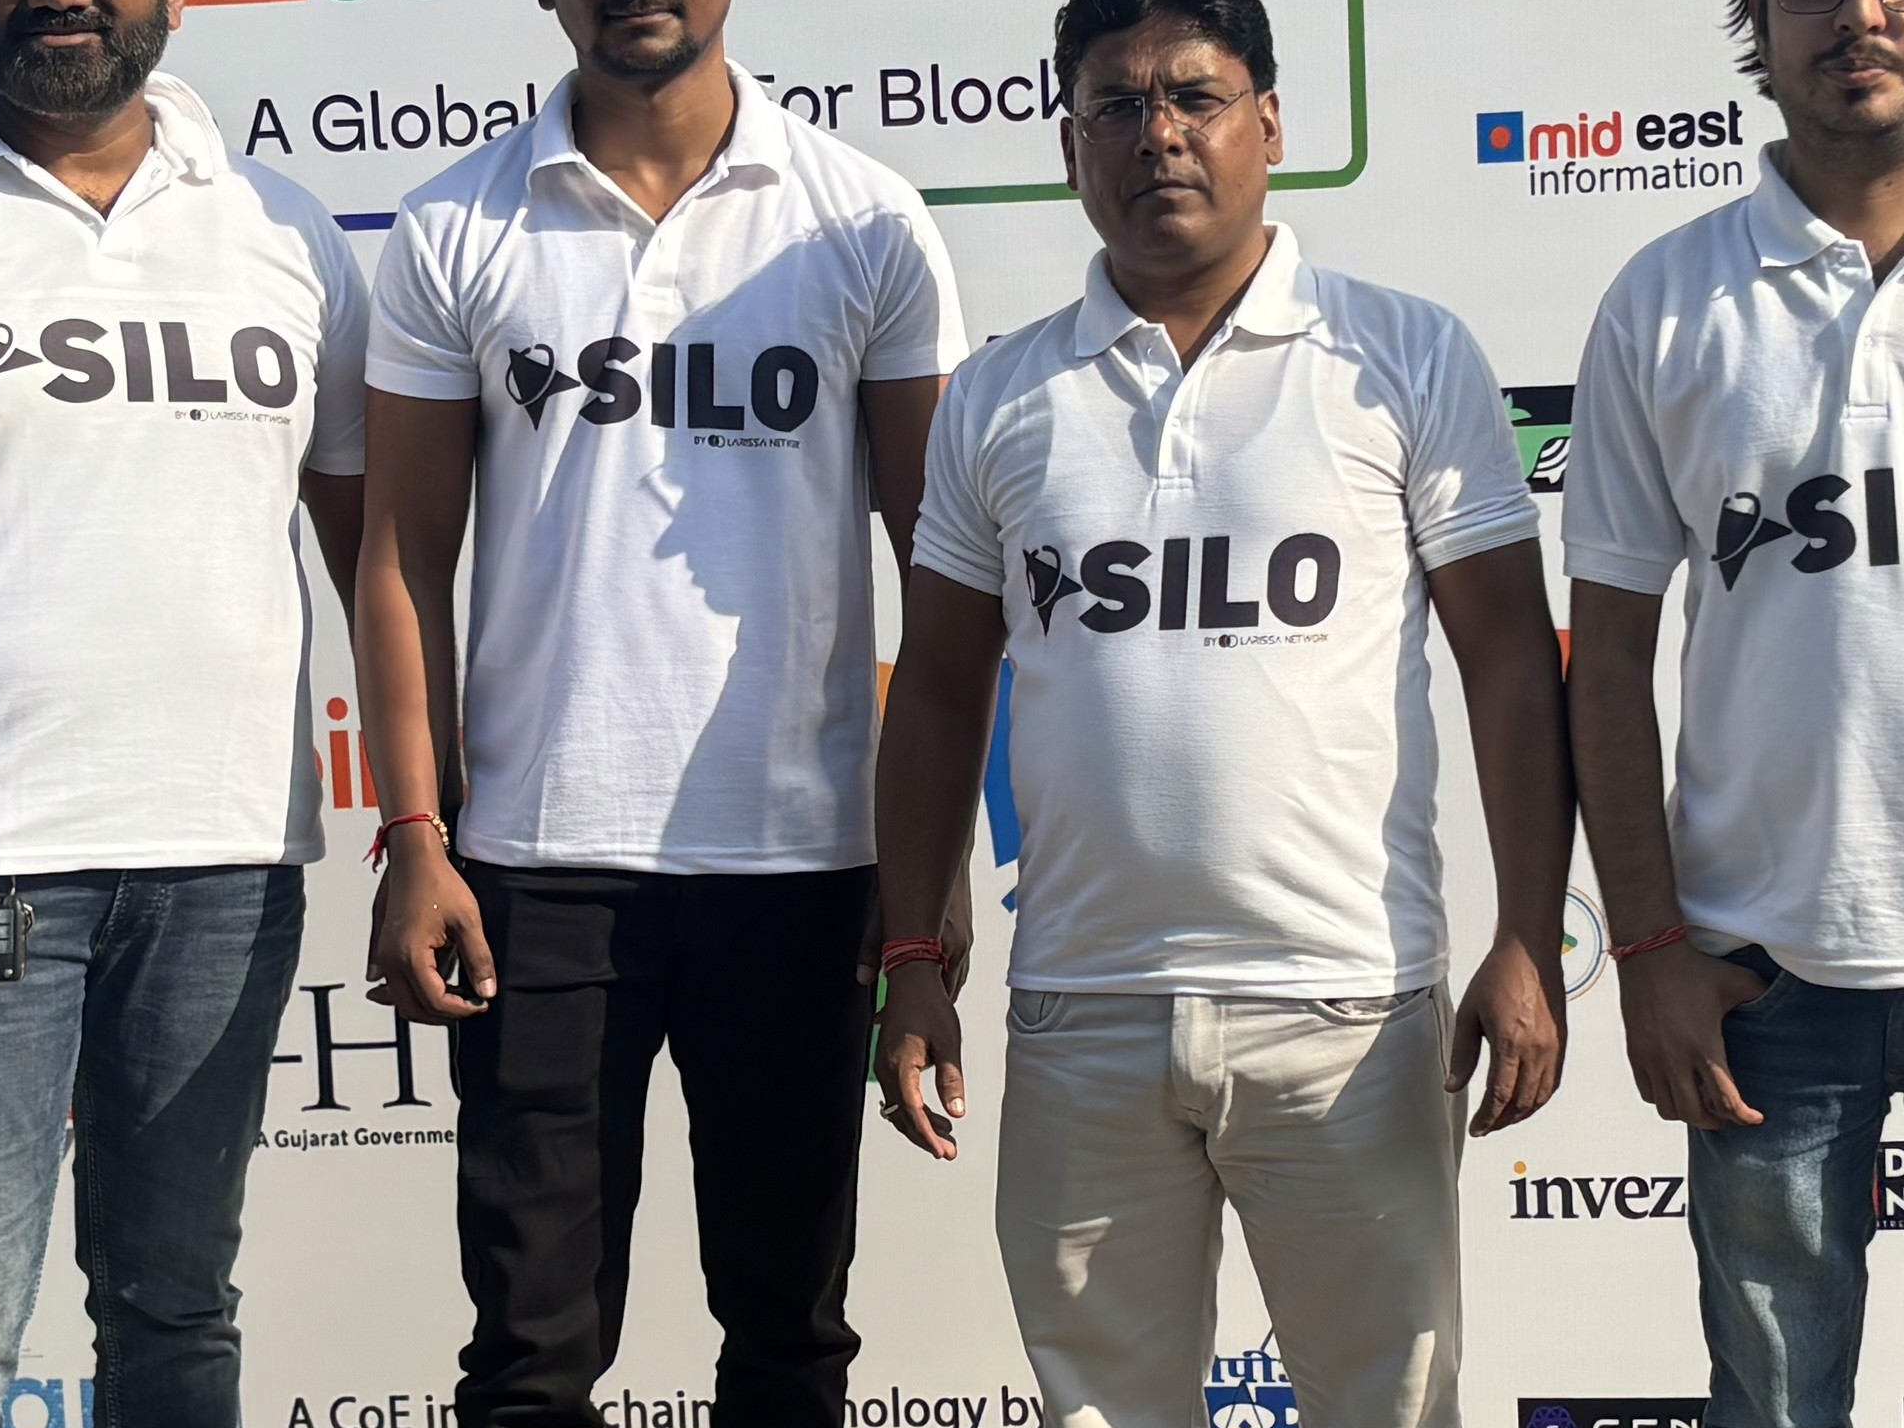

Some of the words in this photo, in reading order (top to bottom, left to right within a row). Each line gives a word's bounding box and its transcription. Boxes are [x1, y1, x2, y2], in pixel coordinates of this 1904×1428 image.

[246, 99, 293, 155] A
[312, 79, 536, 152] Global
[1528, 111, 1622, 159] mid
[1636, 100, 1743, 151] east
[1529, 157, 1742, 196] information
[41, 318, 296, 409] SILO
[576, 336, 819, 431] SILO
[1078, 533, 1341, 634] SILO
[275, 1128, 349, 1149] Gujarat
